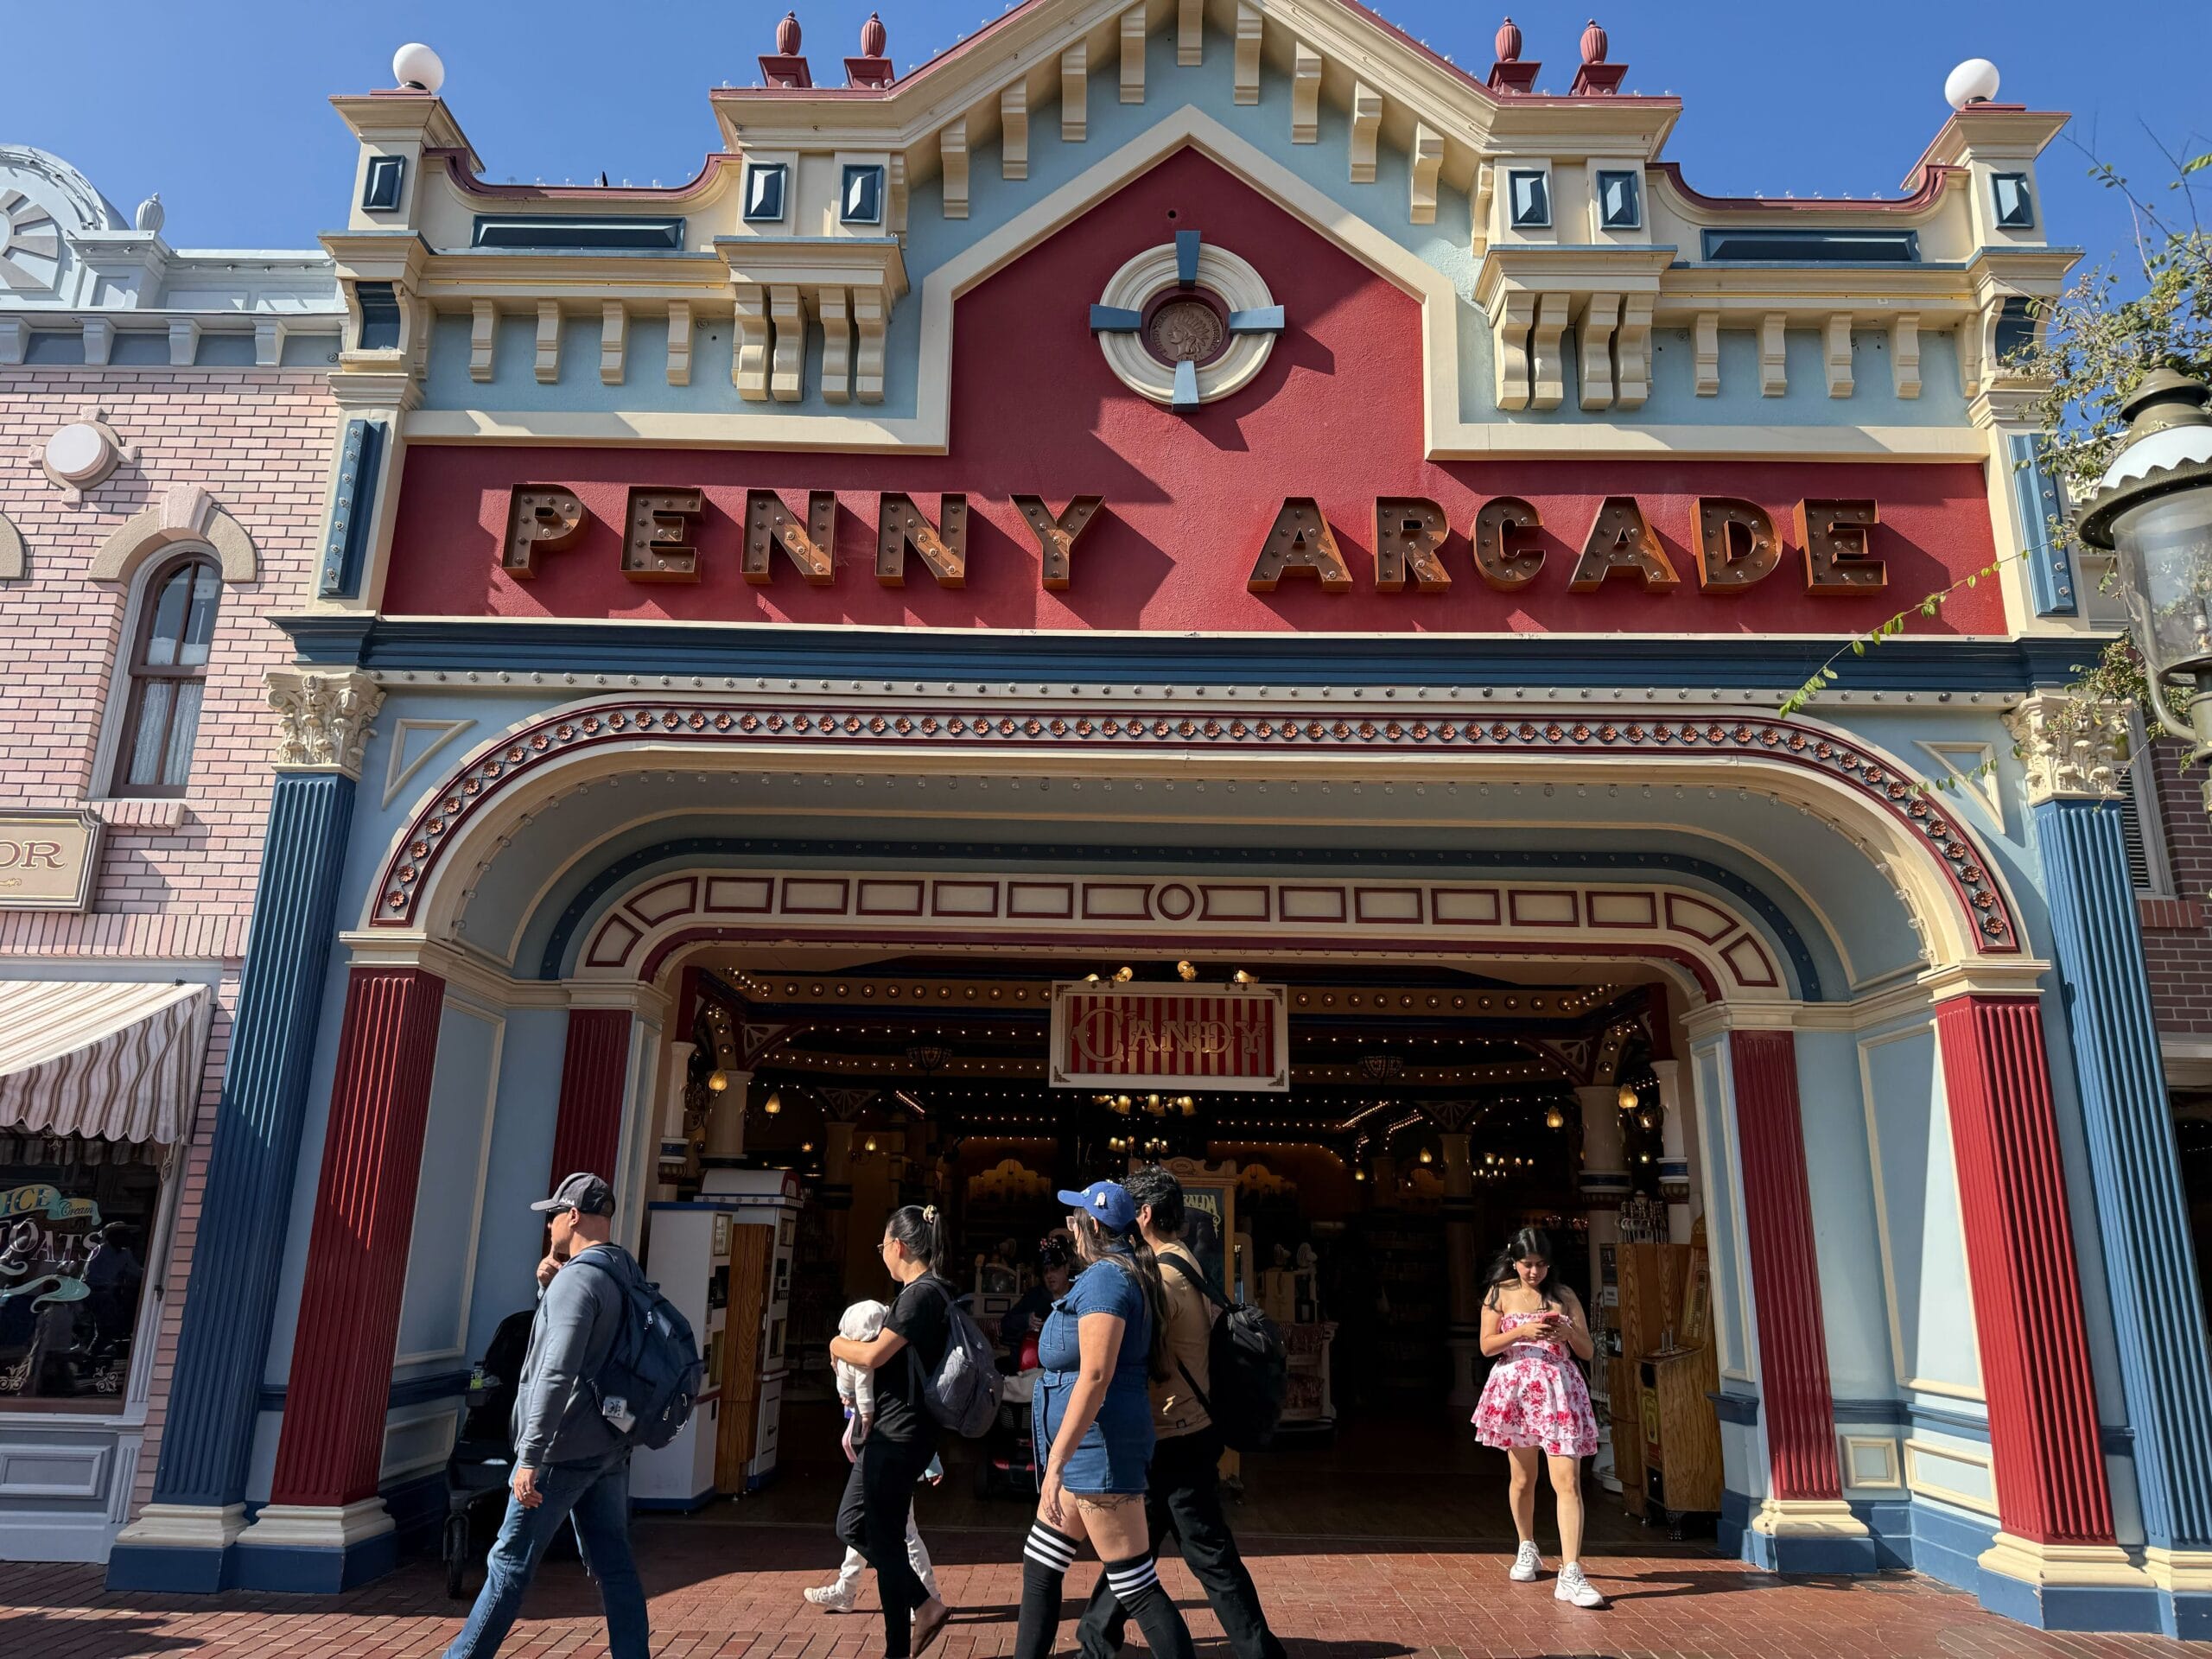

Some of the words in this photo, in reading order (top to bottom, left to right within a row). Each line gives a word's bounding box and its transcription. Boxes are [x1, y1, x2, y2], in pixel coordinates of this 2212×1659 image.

[501, 482, 1106, 590] PENNY
[1247, 495, 1890, 596] ARCADE
[4, 1188, 51, 1215] ICE
[59, 1200, 93, 1217] Cream
